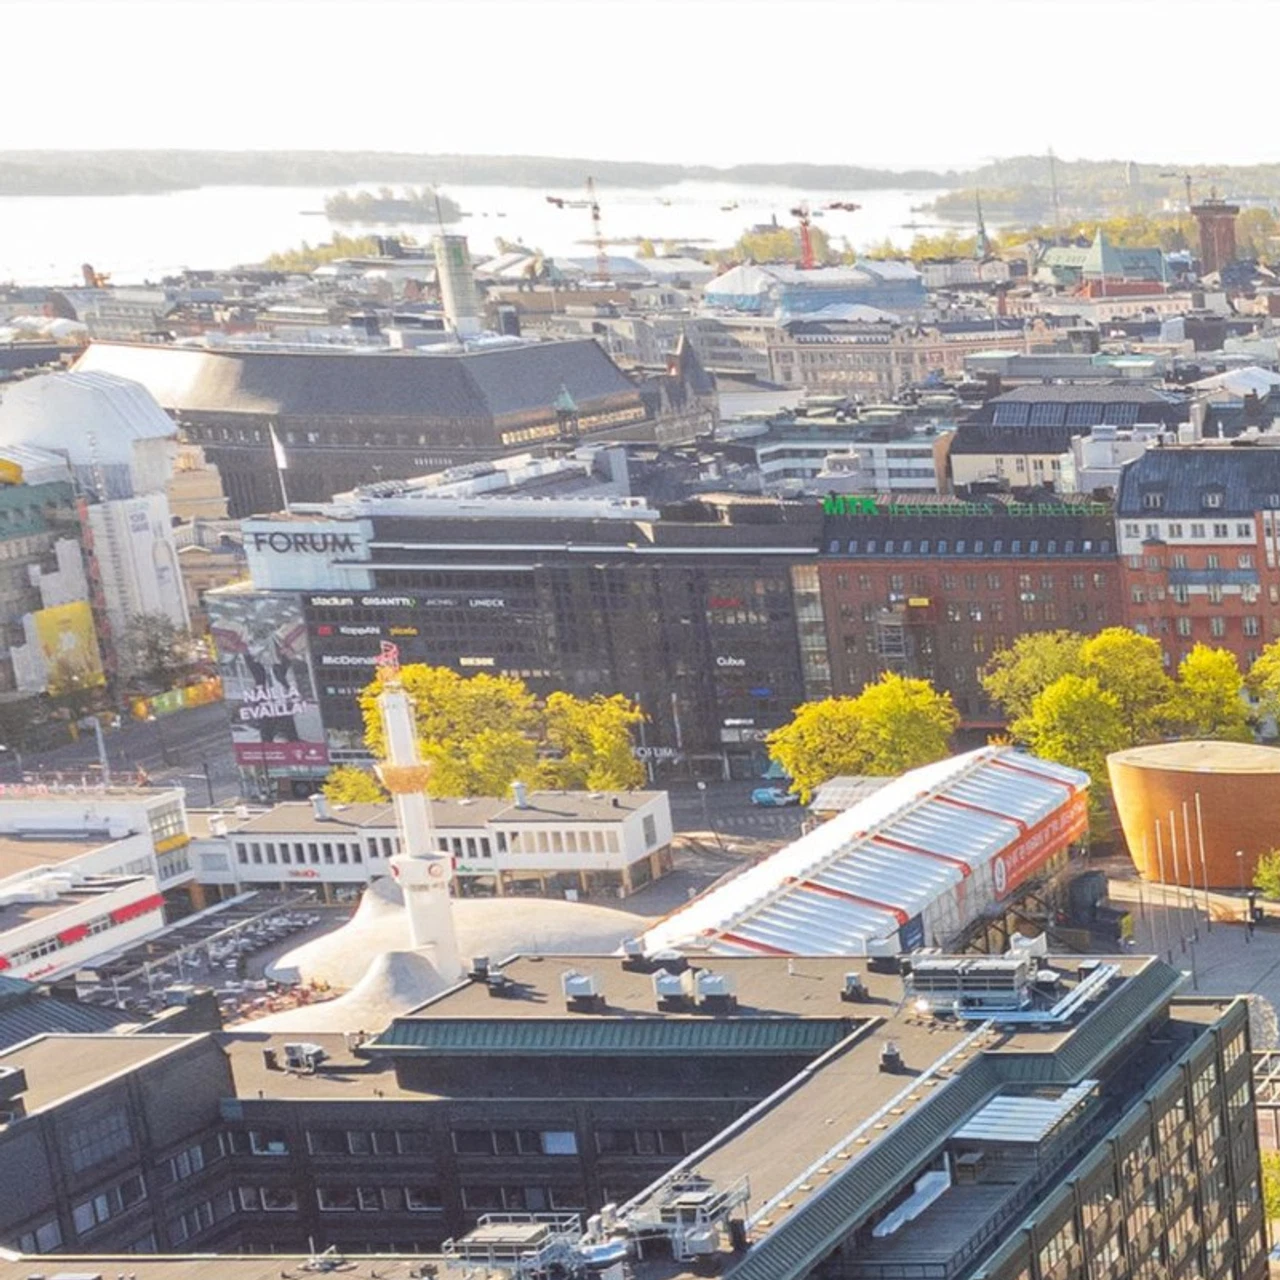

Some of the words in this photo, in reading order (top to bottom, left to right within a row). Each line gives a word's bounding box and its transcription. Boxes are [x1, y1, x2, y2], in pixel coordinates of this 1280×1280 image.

[823, 495, 879, 515] MTK
[254, 532, 355, 552] FORUM
[716, 656, 746, 667] Cubus
